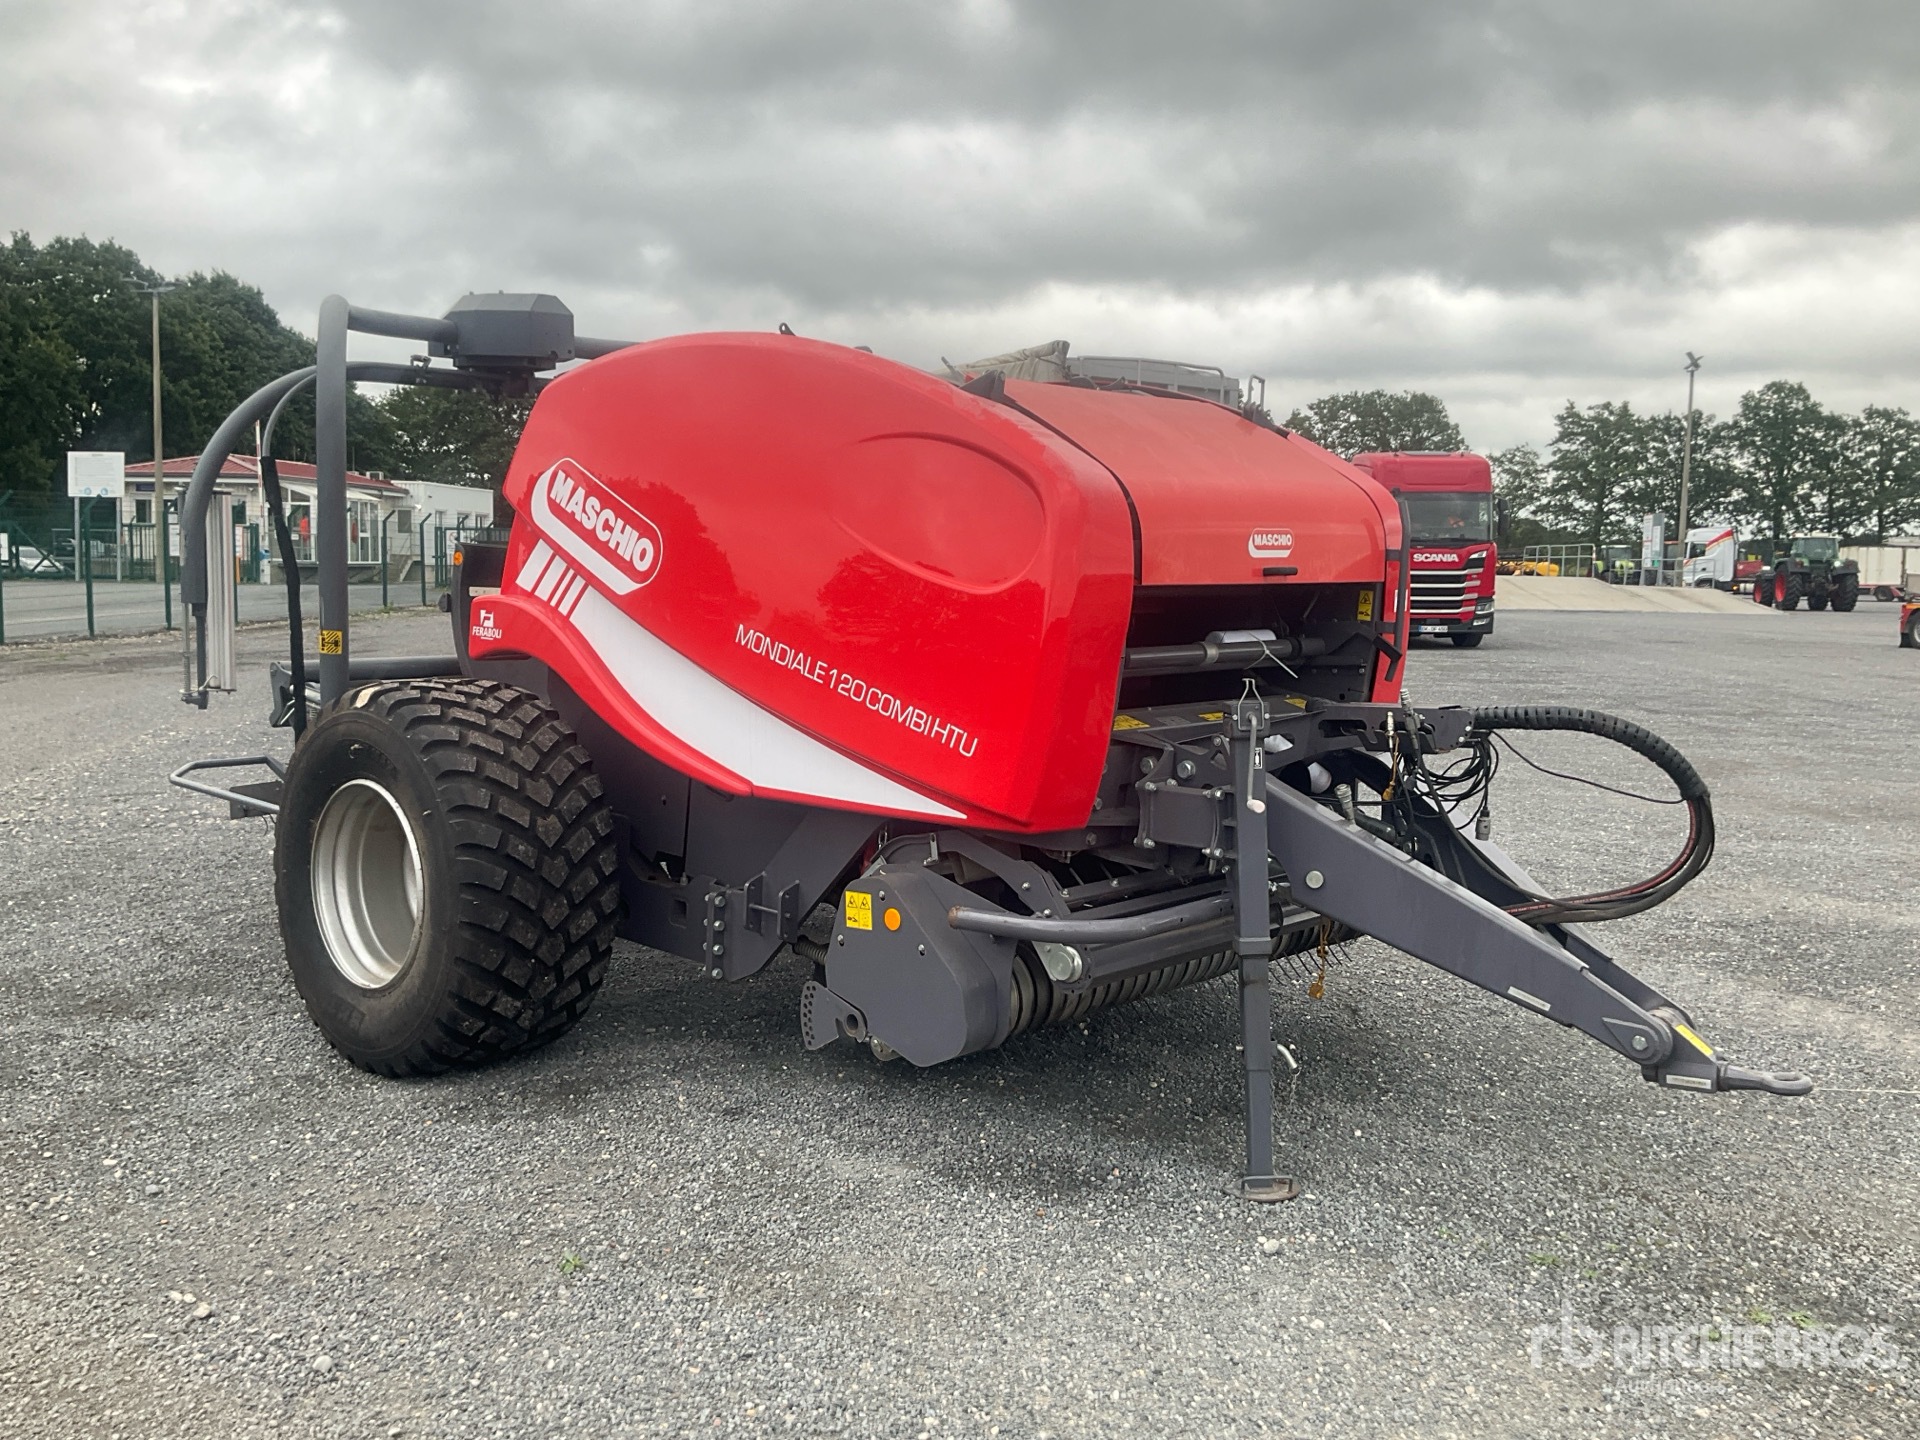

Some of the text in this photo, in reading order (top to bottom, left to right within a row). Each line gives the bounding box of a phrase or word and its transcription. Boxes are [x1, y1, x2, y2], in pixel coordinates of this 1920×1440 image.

[549, 469, 654, 572] MASCHIO
[1253, 533, 1292, 546] MASCHIO
[1412, 553, 1459, 563] SCANIA
[472, 626, 502, 639] FERABOLI
[735, 624, 978, 758] MONDIALE 120 COMBI HTU
